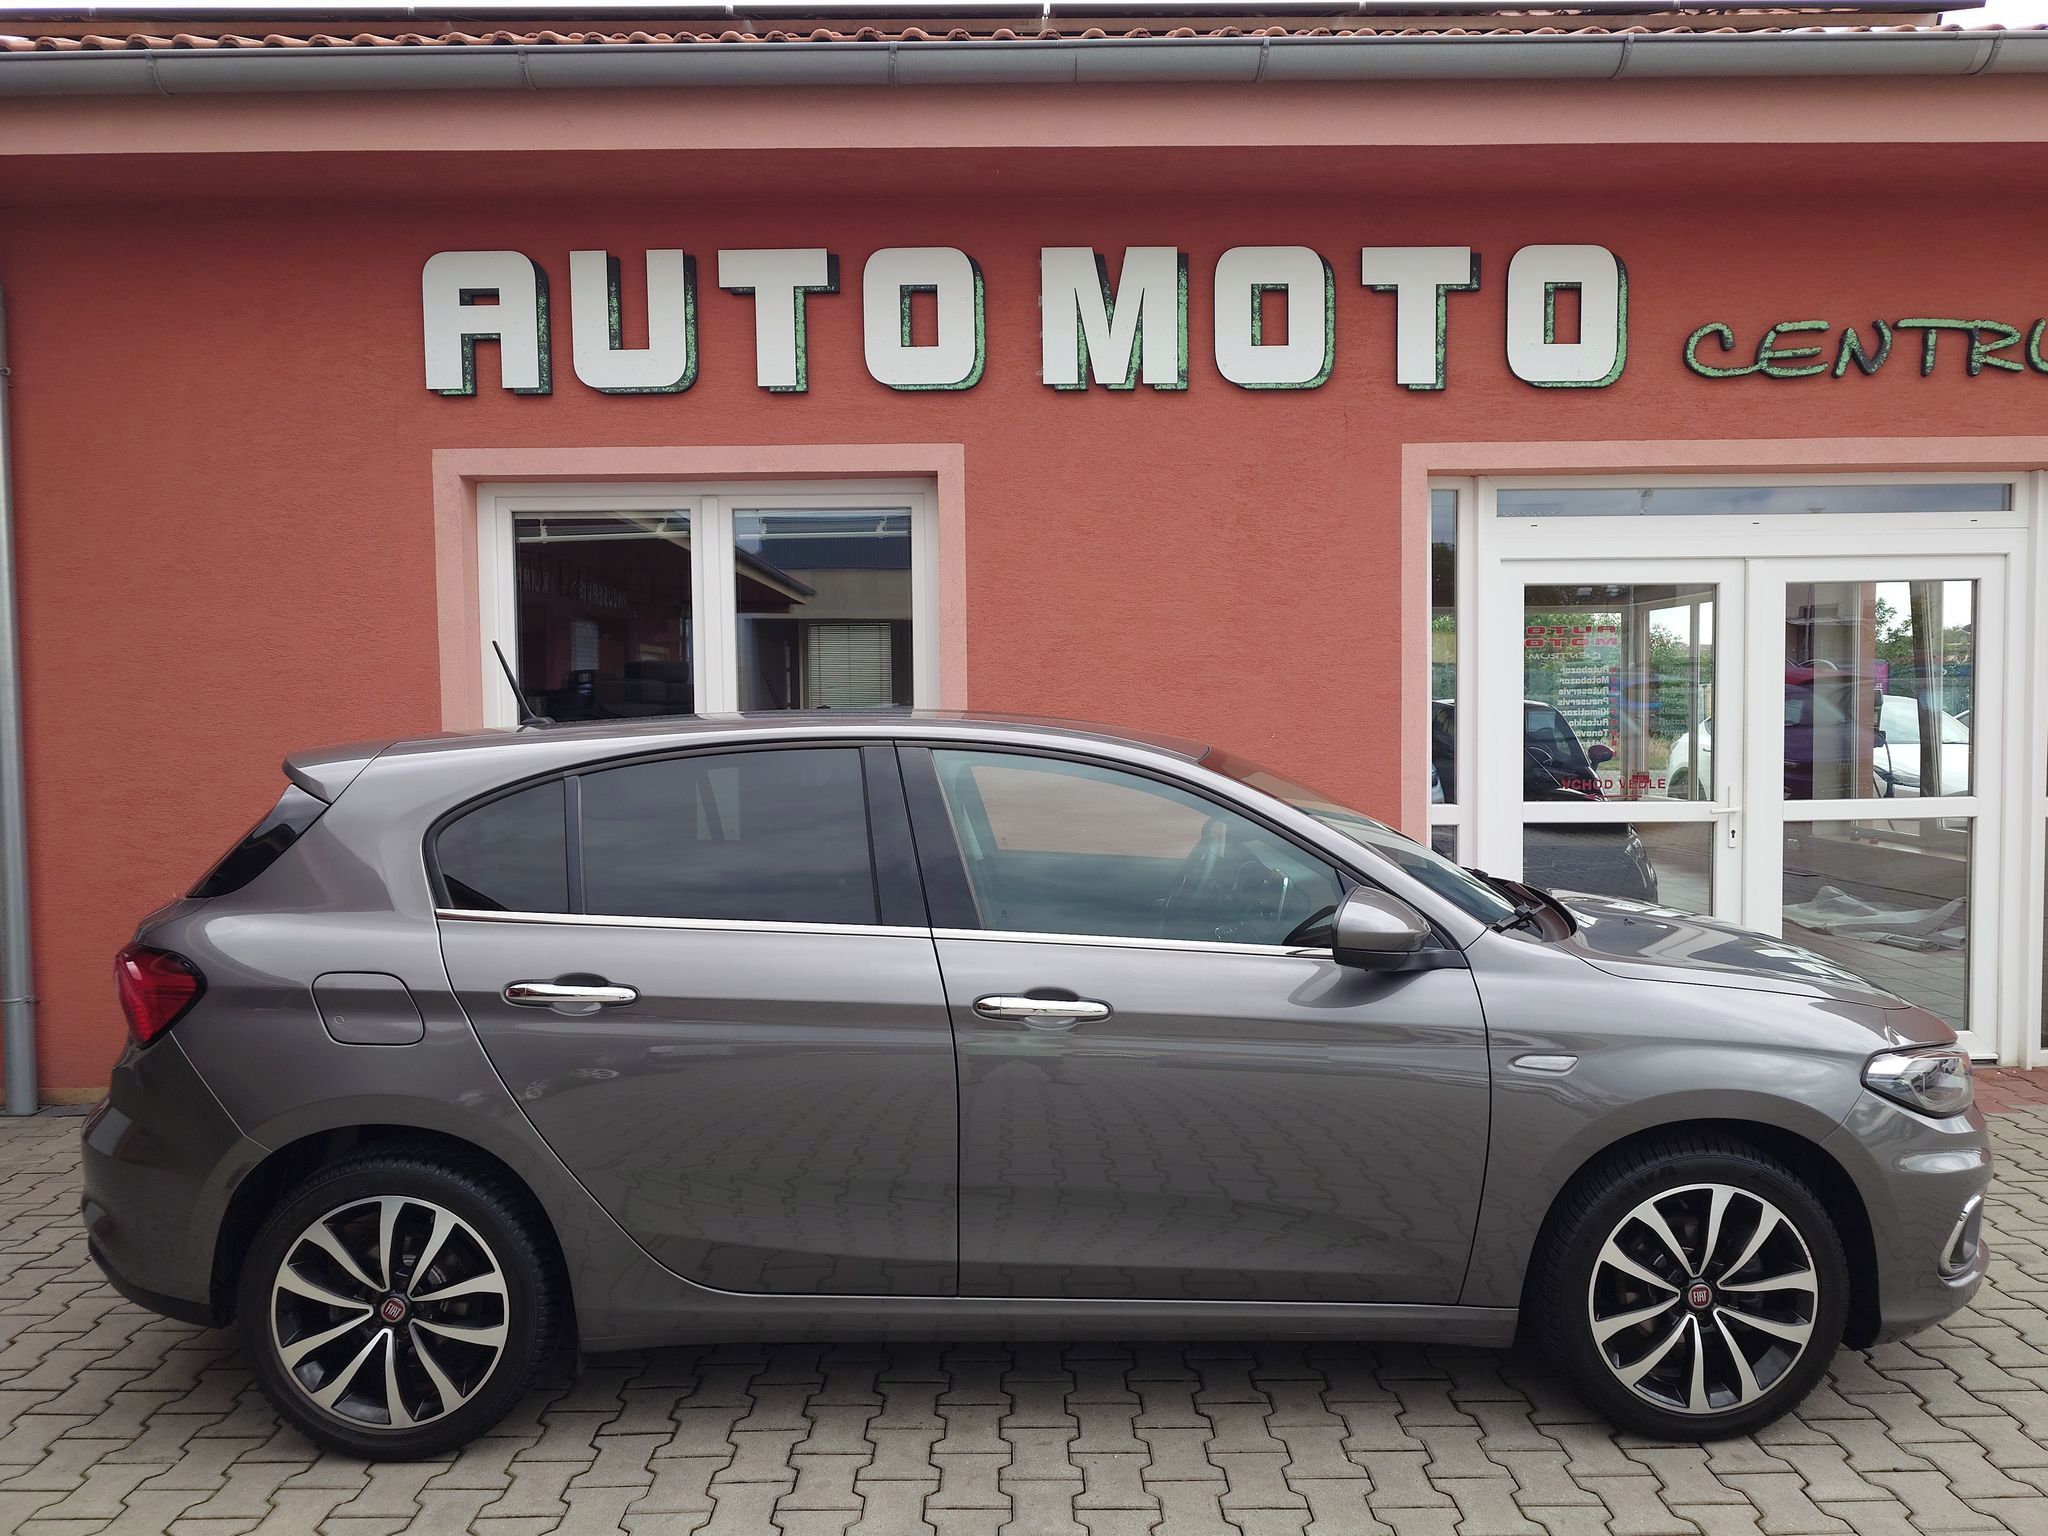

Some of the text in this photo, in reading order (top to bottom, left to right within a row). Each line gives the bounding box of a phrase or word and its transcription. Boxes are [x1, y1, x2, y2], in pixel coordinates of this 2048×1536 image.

[422, 246, 986, 396] AUTO
[1040, 244, 1629, 391] MOTO
[1561, 778, 1666, 790] VCHOD VEDLE
[1693, 1290, 1707, 1302] FIAT
[385, 1302, 402, 1318] FIAT
